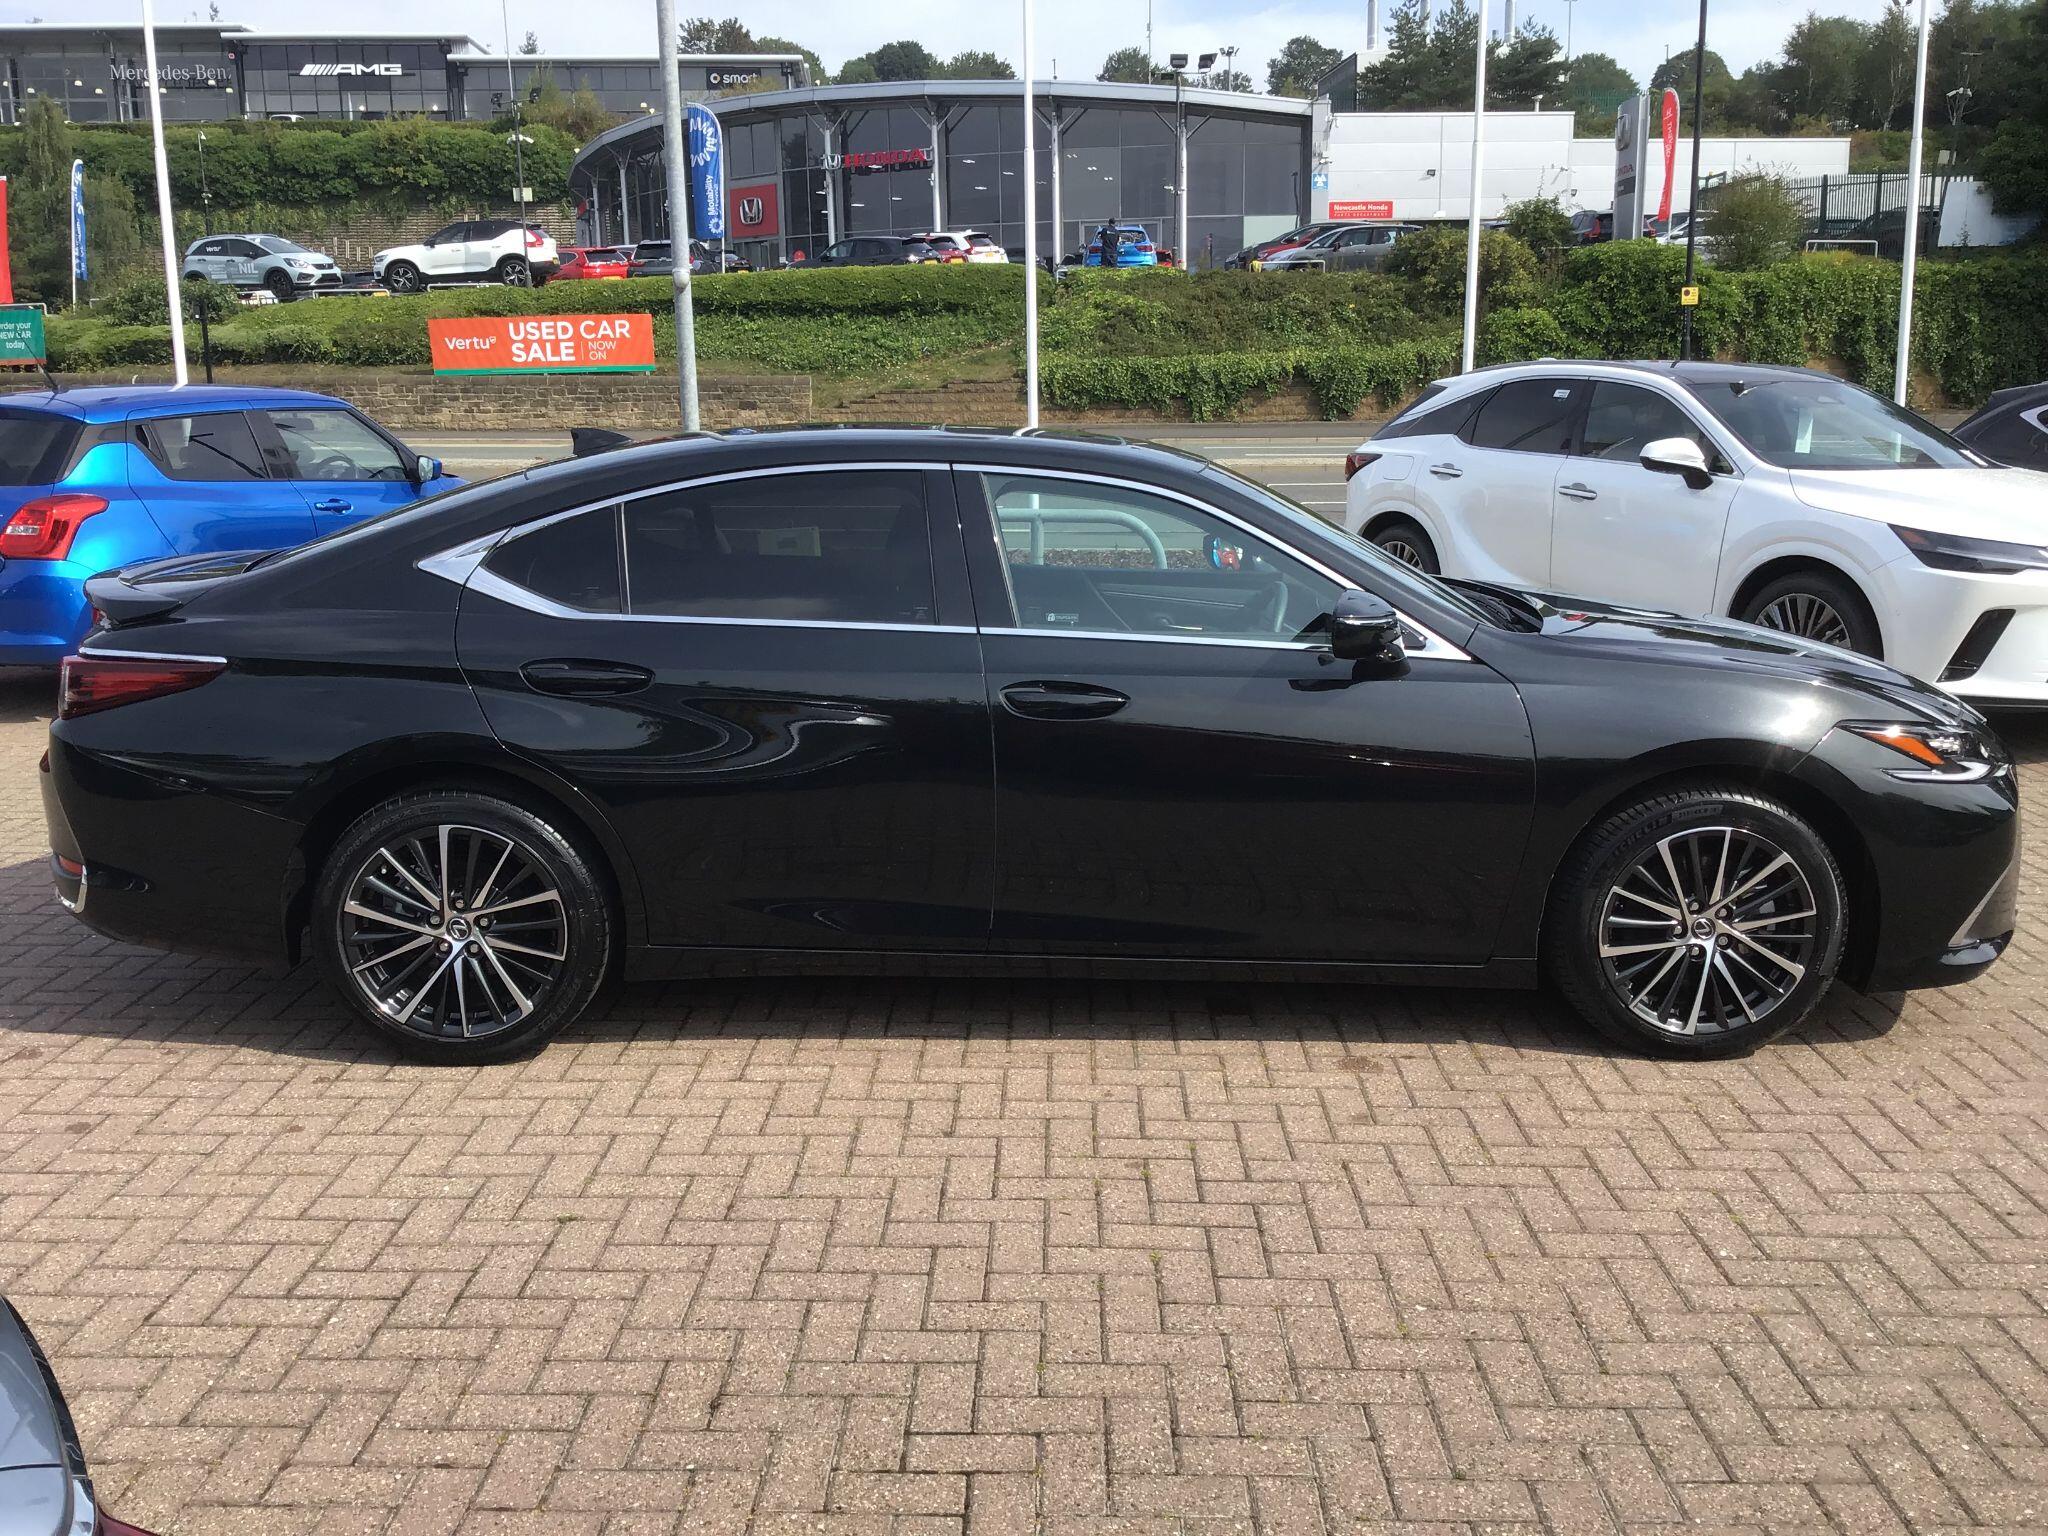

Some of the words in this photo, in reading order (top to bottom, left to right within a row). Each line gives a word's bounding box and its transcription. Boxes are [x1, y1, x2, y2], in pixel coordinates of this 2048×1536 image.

[332, 64, 402, 75] AMG
[844, 148, 926, 167] HONDA
[705, 174, 716, 216] Motability
[238, 262, 259, 274] NIL
[16, 322, 31, 331] your
[508, 321, 574, 341] USED
[579, 320, 631, 339] CAR
[16, 331, 32, 339] CAR
[6, 341, 25, 350] today
[445, 336, 490, 350] Vertu
[588, 340, 617, 351] NOW
[511, 341, 576, 362] SALE
[589, 350, 607, 361] ON
